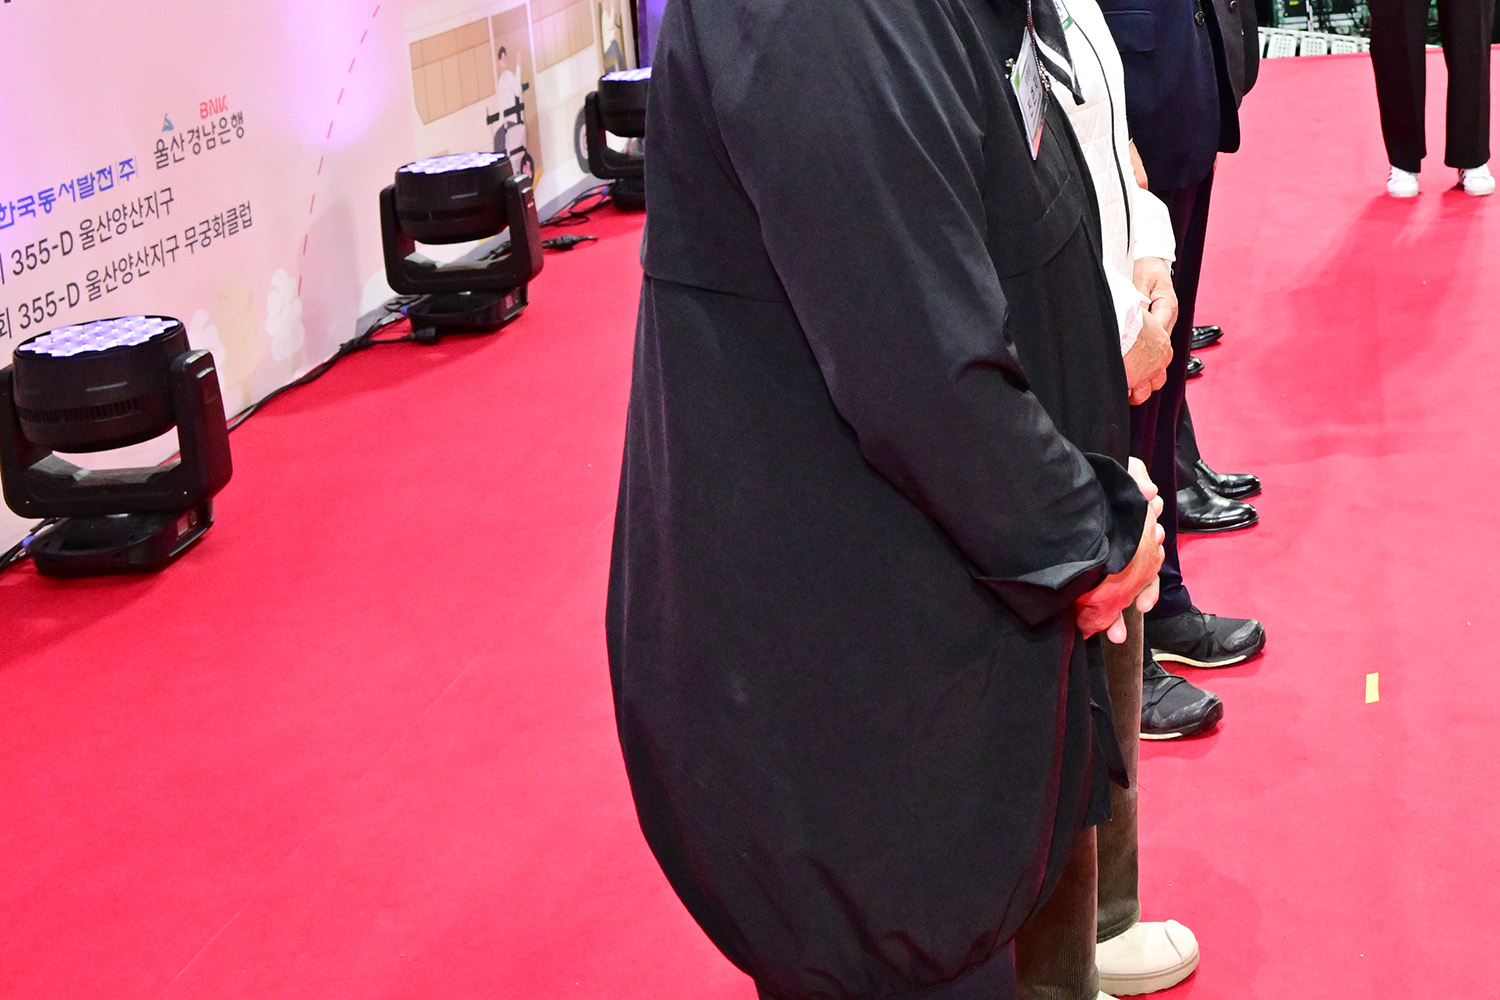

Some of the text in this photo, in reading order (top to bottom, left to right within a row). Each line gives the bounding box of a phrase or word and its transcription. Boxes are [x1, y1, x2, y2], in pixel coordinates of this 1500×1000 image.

[200, 95, 228, 119] BNK
[11, 230, 74, 276] 355-D
[79, 187, 175, 251] 울산양산지구
[18, 282, 80, 330] 355-D
[85, 234, 180, 302] 울산양산지구
[184, 200, 253, 255] 무궁화클럽
